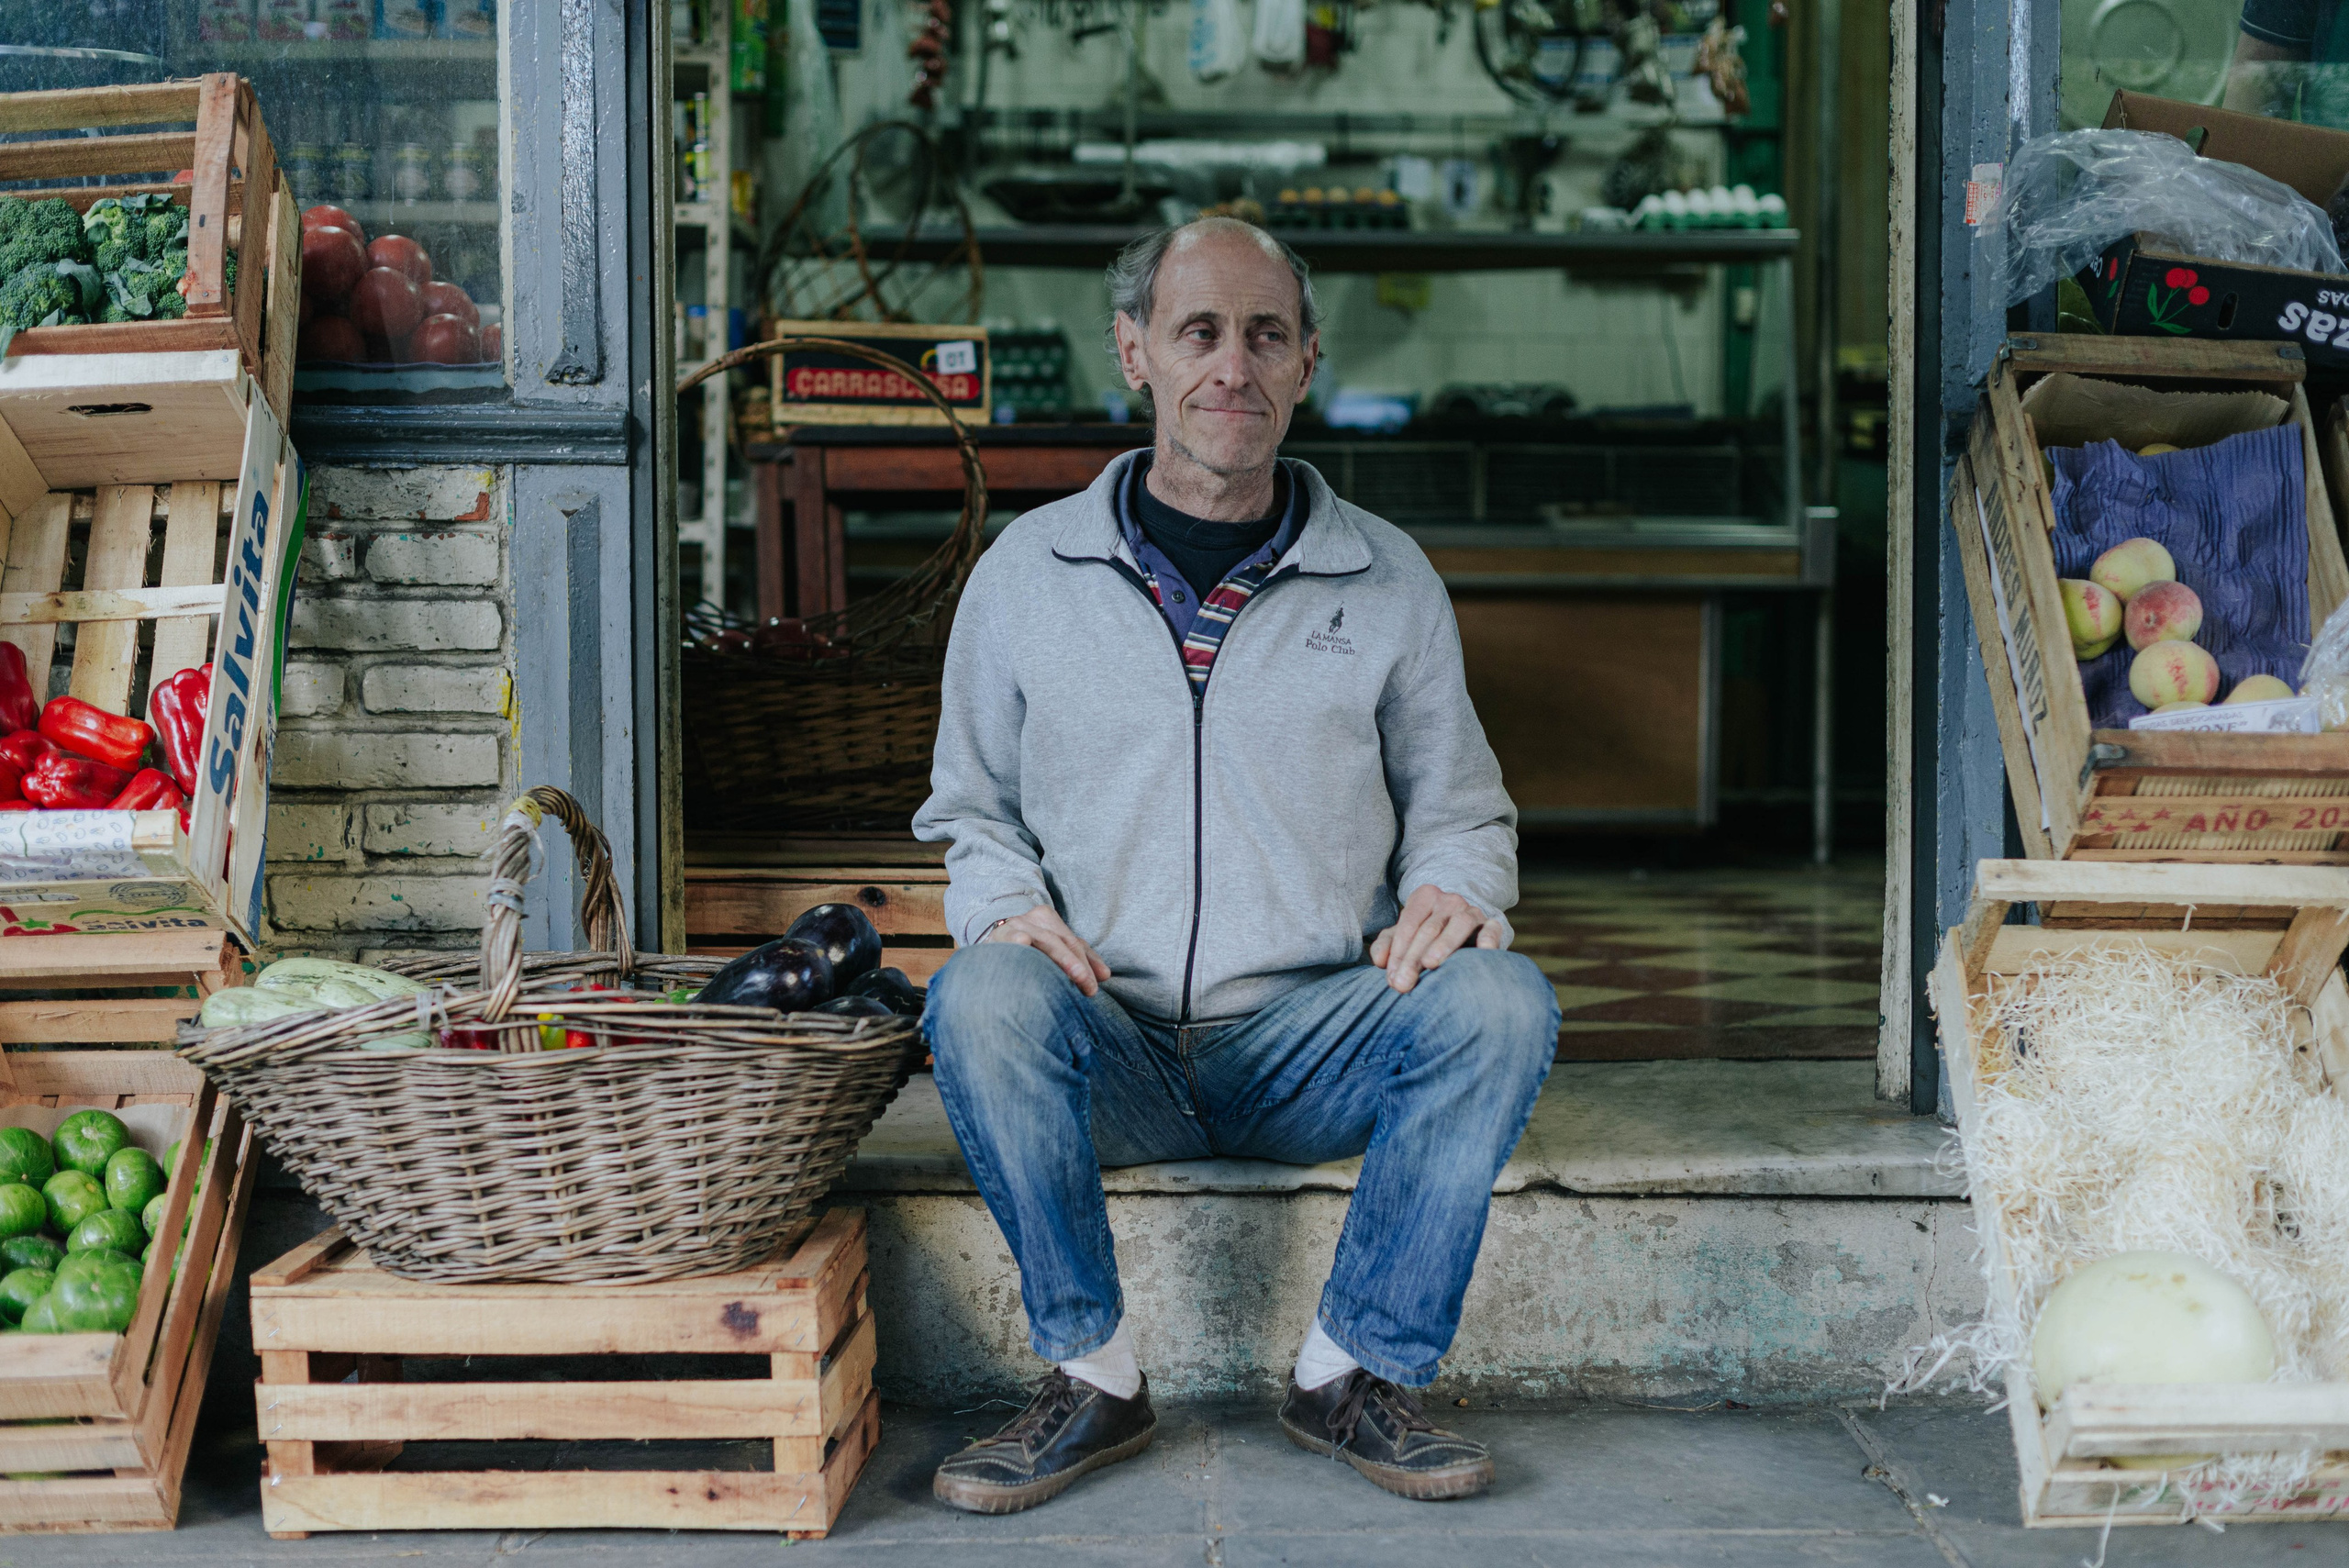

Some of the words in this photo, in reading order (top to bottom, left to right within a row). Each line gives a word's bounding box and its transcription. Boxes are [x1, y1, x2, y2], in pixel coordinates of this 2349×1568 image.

[1985, 480, 2021, 611] ANDRES
[209, 490, 270, 808] Salvita
[1306, 638, 1328, 652] Polo
[1331, 644, 1355, 655] Club
[1322, 633, 1352, 646] MANSA
[2182, 804, 2270, 833] AÑO
[82, 916, 208, 930] Salvita
